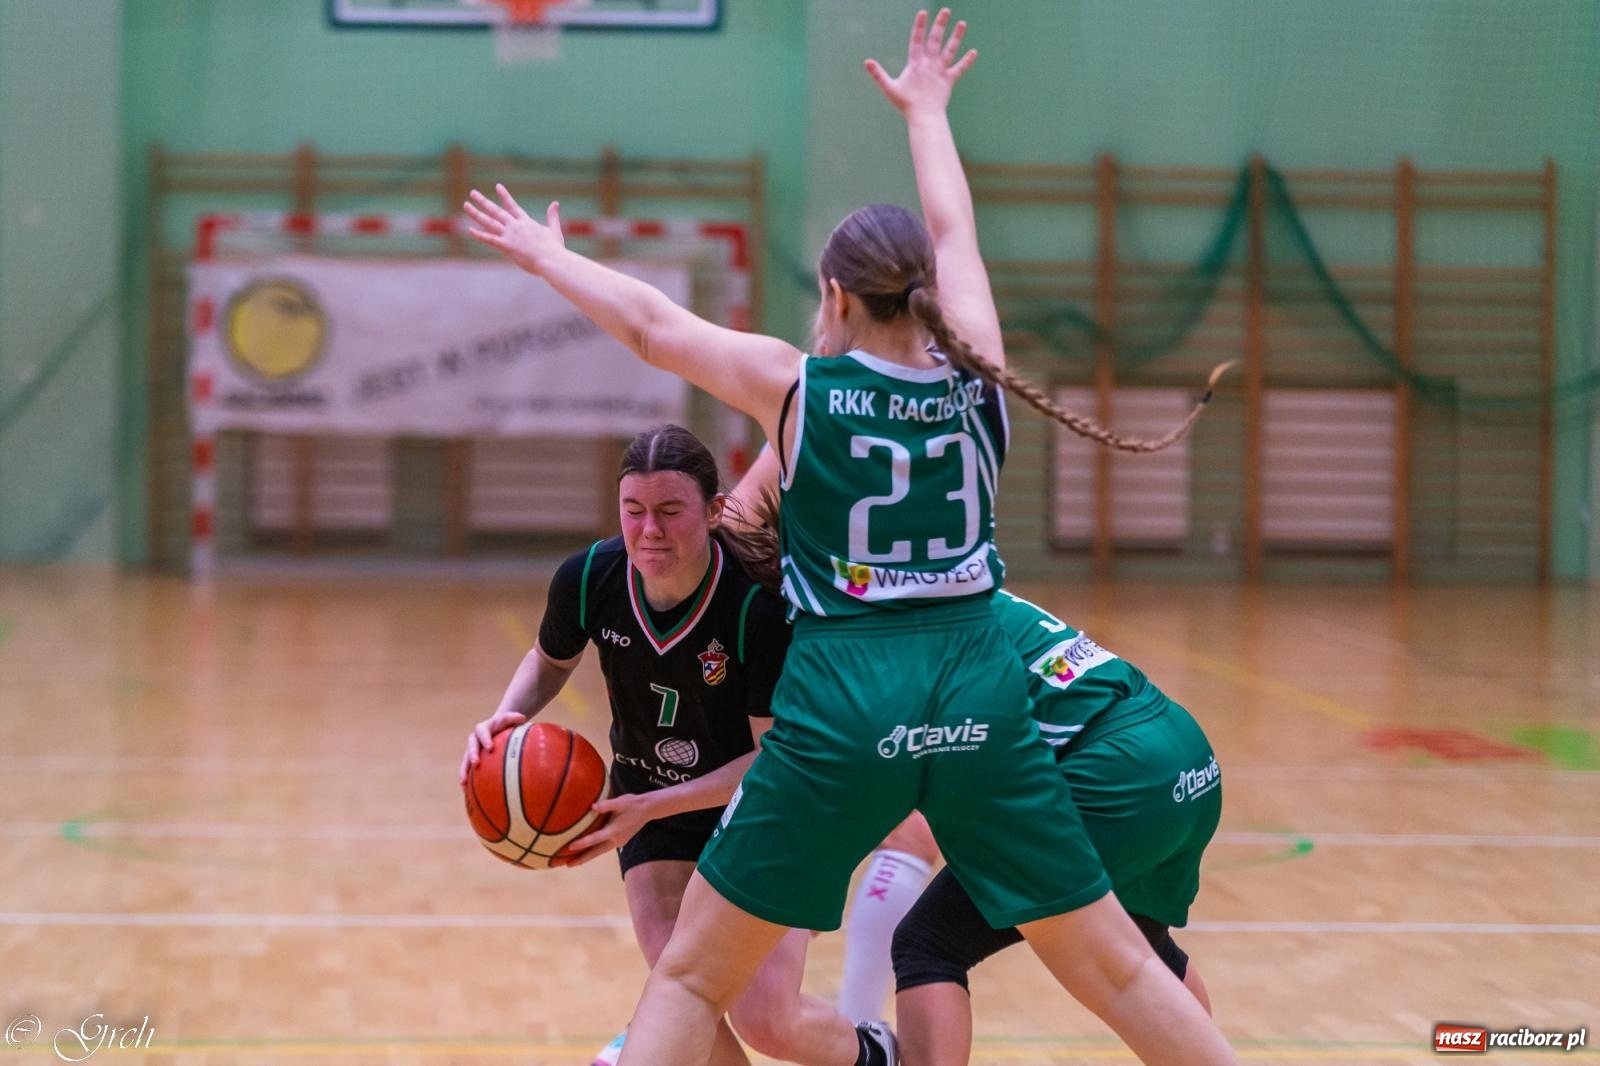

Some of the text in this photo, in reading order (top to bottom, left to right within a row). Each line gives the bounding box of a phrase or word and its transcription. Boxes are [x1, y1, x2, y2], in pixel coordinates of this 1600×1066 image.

[828, 388, 876, 417] RKK
[848, 431, 981, 564] 23
[649, 682, 680, 727] 7
[615, 752, 652, 770] CTL
